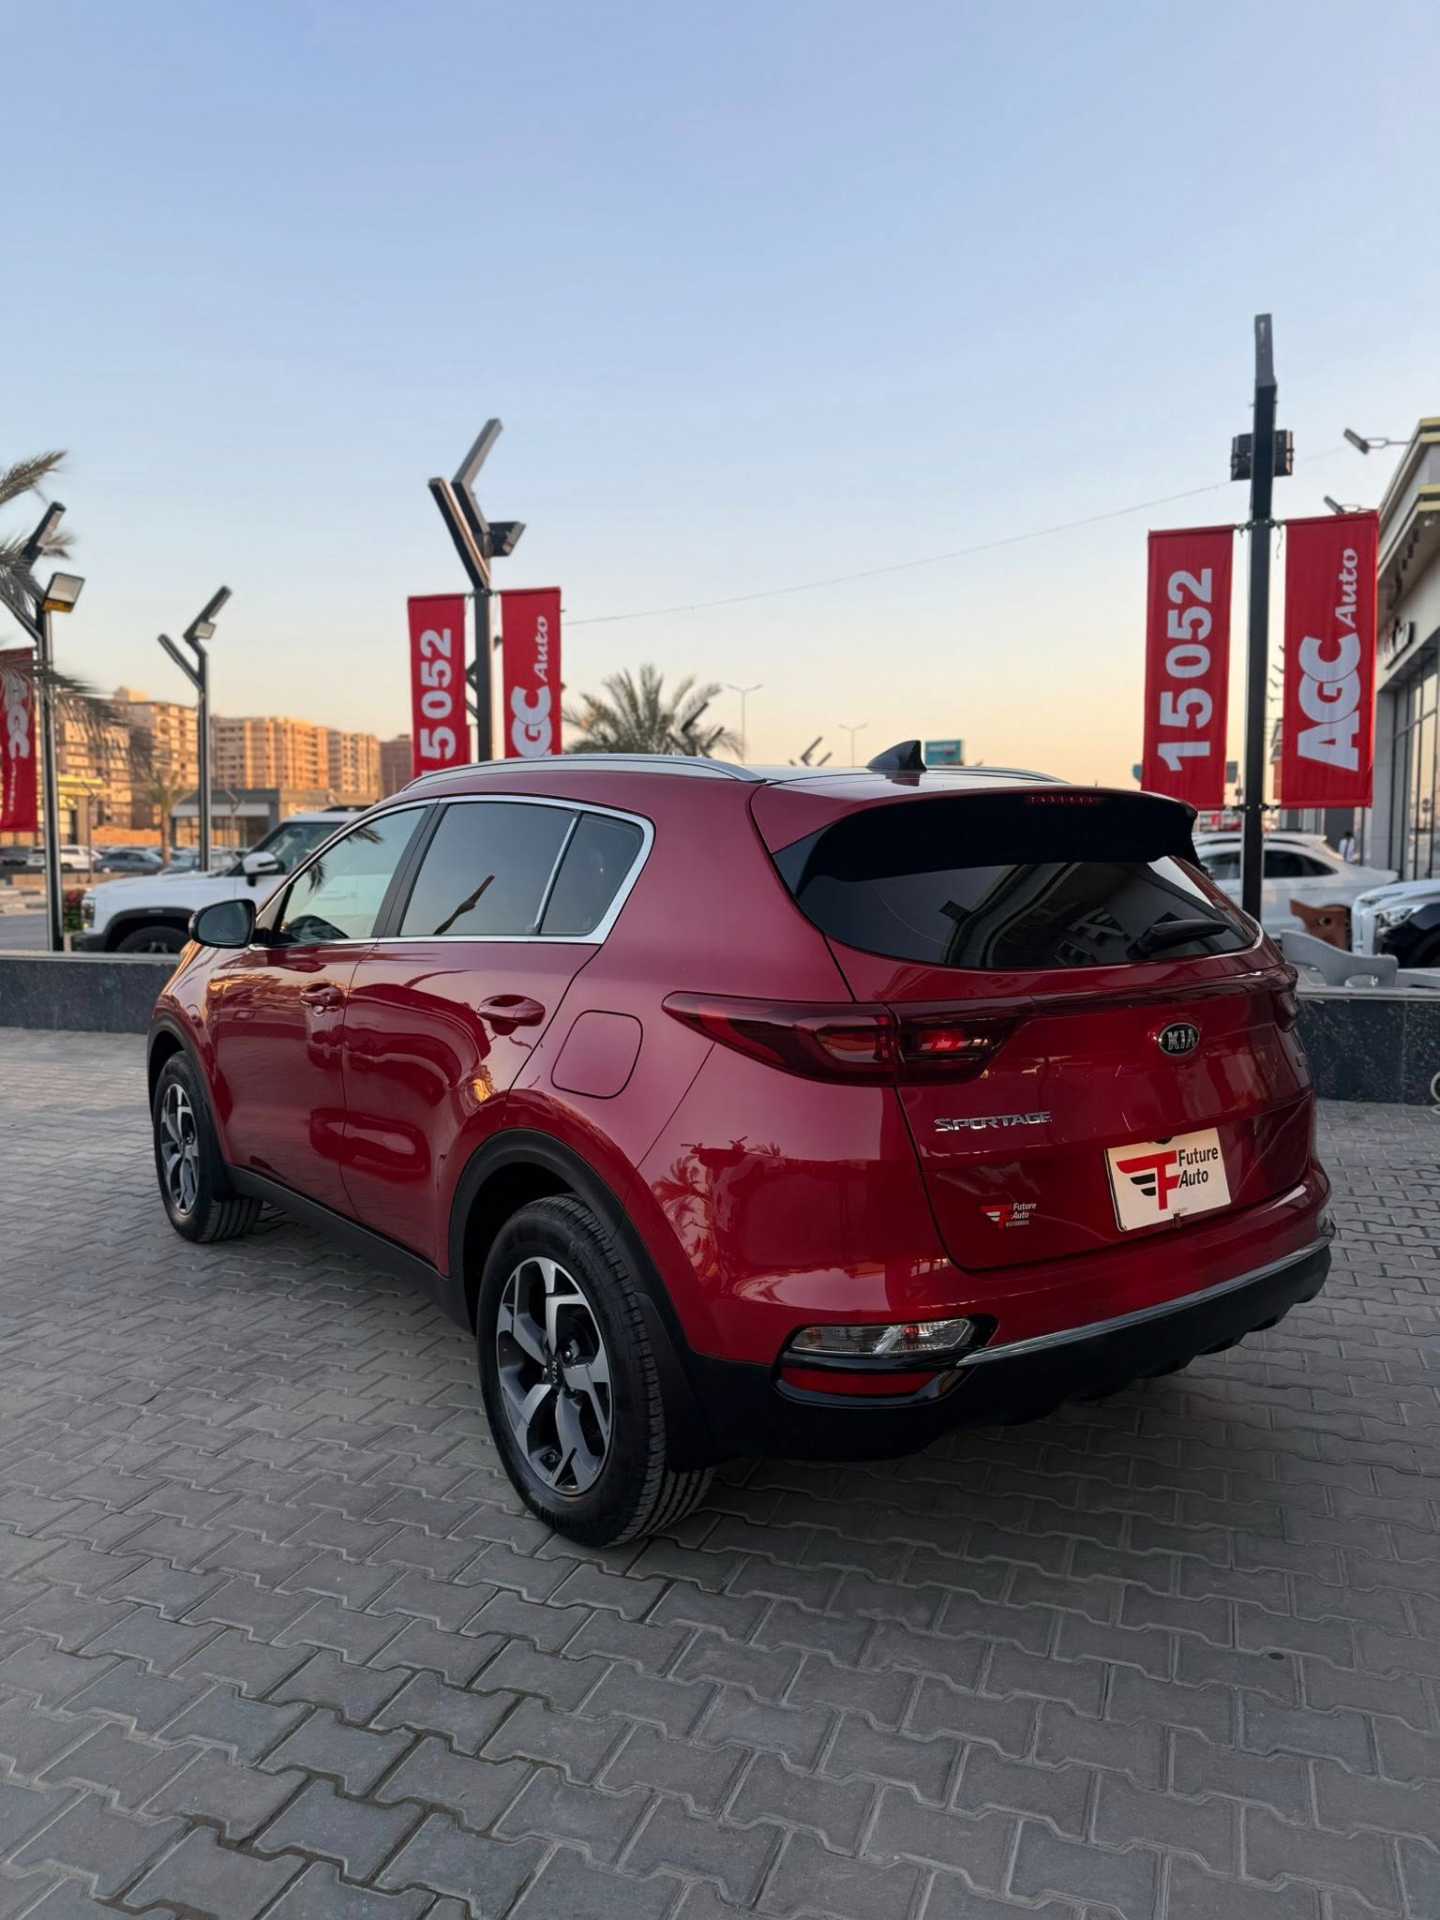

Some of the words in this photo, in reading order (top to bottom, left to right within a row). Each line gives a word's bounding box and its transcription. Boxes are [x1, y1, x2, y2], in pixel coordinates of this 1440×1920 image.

[1298, 632, 1361, 772] AGC
[1335, 548, 1359, 629] Auto
[511, 686, 552, 758] GC
[533, 615, 549, 683] Auto
[420, 627, 456, 779] 5052
[1167, 1028, 1196, 1050] KIA
[934, 1111, 1052, 1132] SPORTAGE
[1178, 1147, 1219, 1167] Future
[1178, 1169, 1209, 1188] Auto
